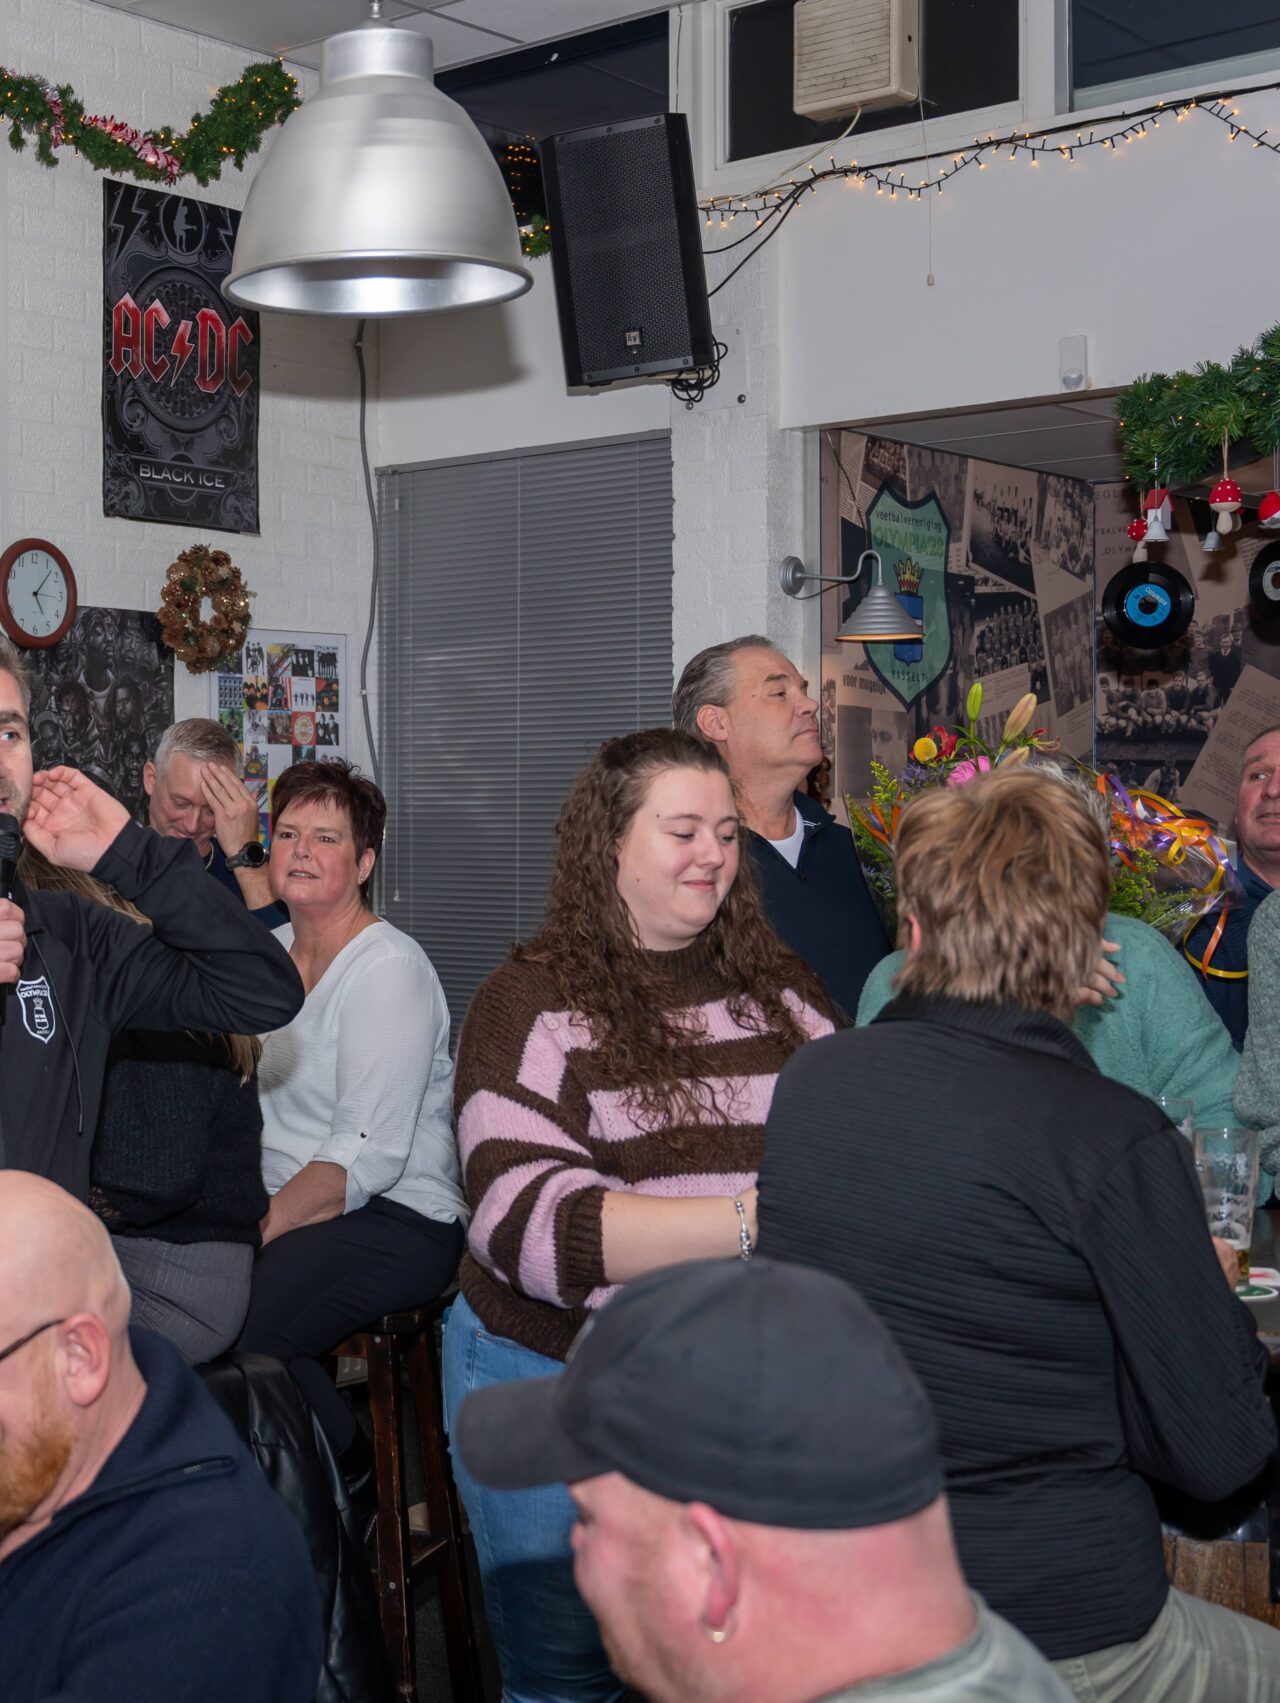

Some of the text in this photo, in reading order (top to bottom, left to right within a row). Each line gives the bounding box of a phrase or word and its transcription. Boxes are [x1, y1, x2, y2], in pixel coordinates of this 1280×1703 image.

[139, 463, 225, 488] BLACK ICE
[876, 510, 943, 534] voetbalvereniging
[18, 556, 25, 567] 11
[31, 552, 39, 564] 12
[53, 571, 59, 583] 2
[58, 591, 63, 602] 3
[1145, 586, 1168, 606] Columbia
[54, 608, 59, 618] 4
[32, 624, 38, 635] 6
[45, 621, 51, 631] 5
[842, 674, 858, 688] voor
[891, 669, 925, 682] HASSELT
